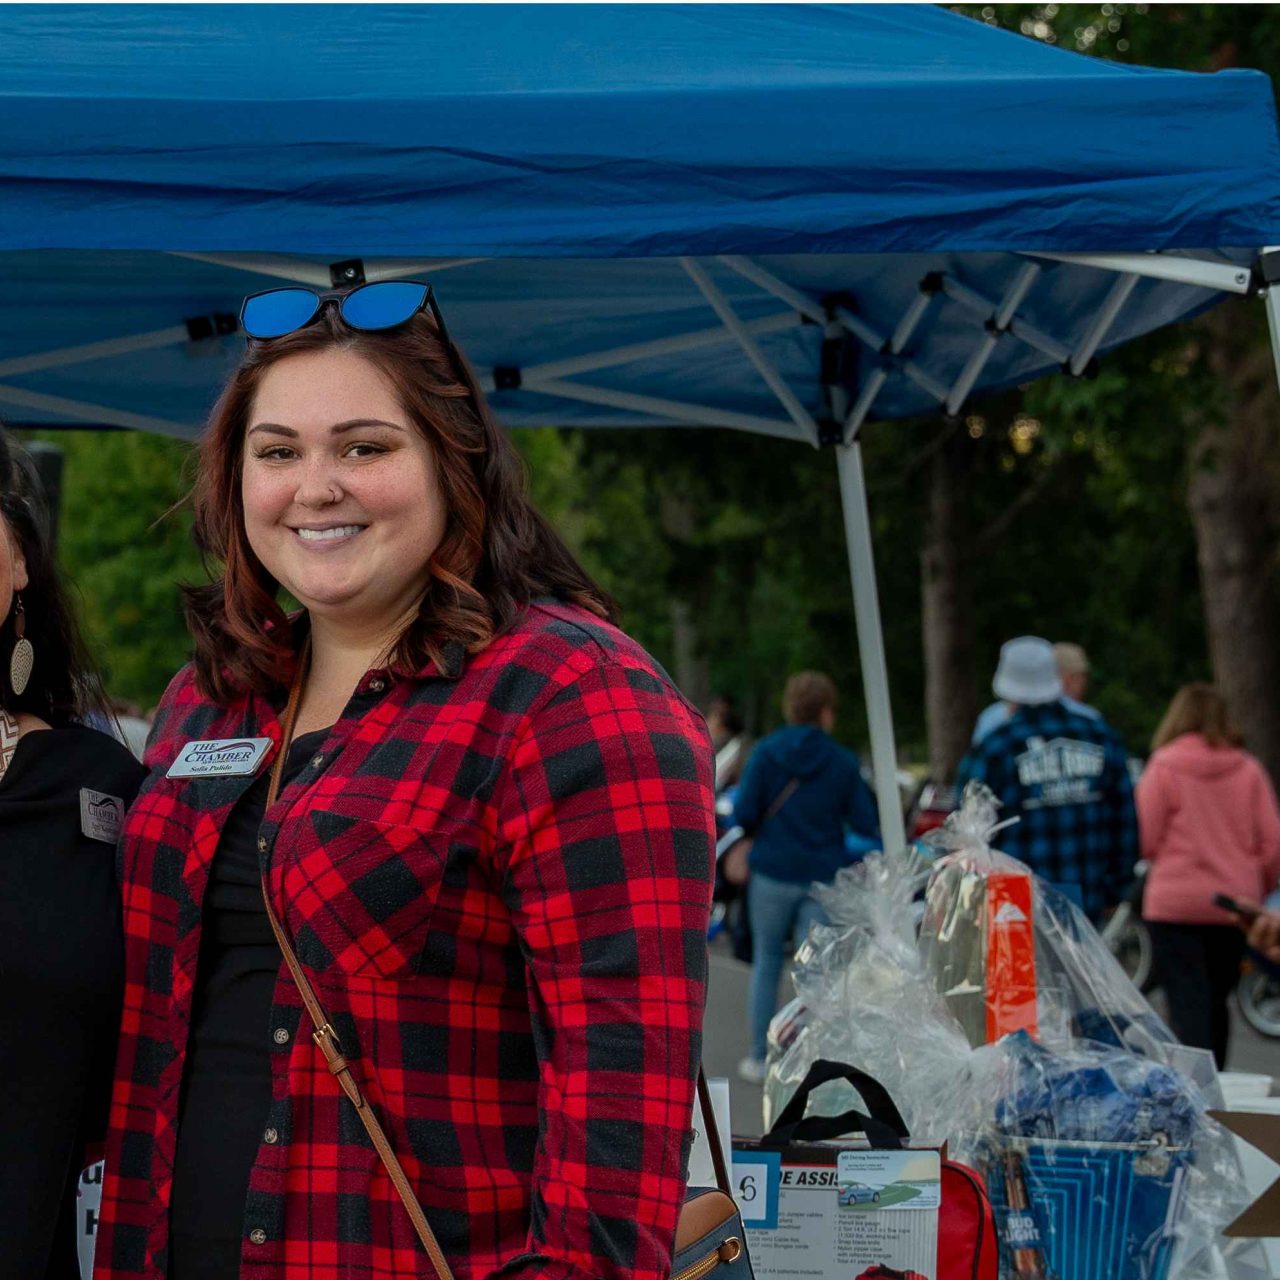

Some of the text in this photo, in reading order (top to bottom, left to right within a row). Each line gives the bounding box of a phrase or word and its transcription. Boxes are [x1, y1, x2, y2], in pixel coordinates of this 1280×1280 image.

[193, 743, 219, 751] THE
[185, 751, 252, 763] CHAMBER
[739, 1175, 756, 1201] 6
